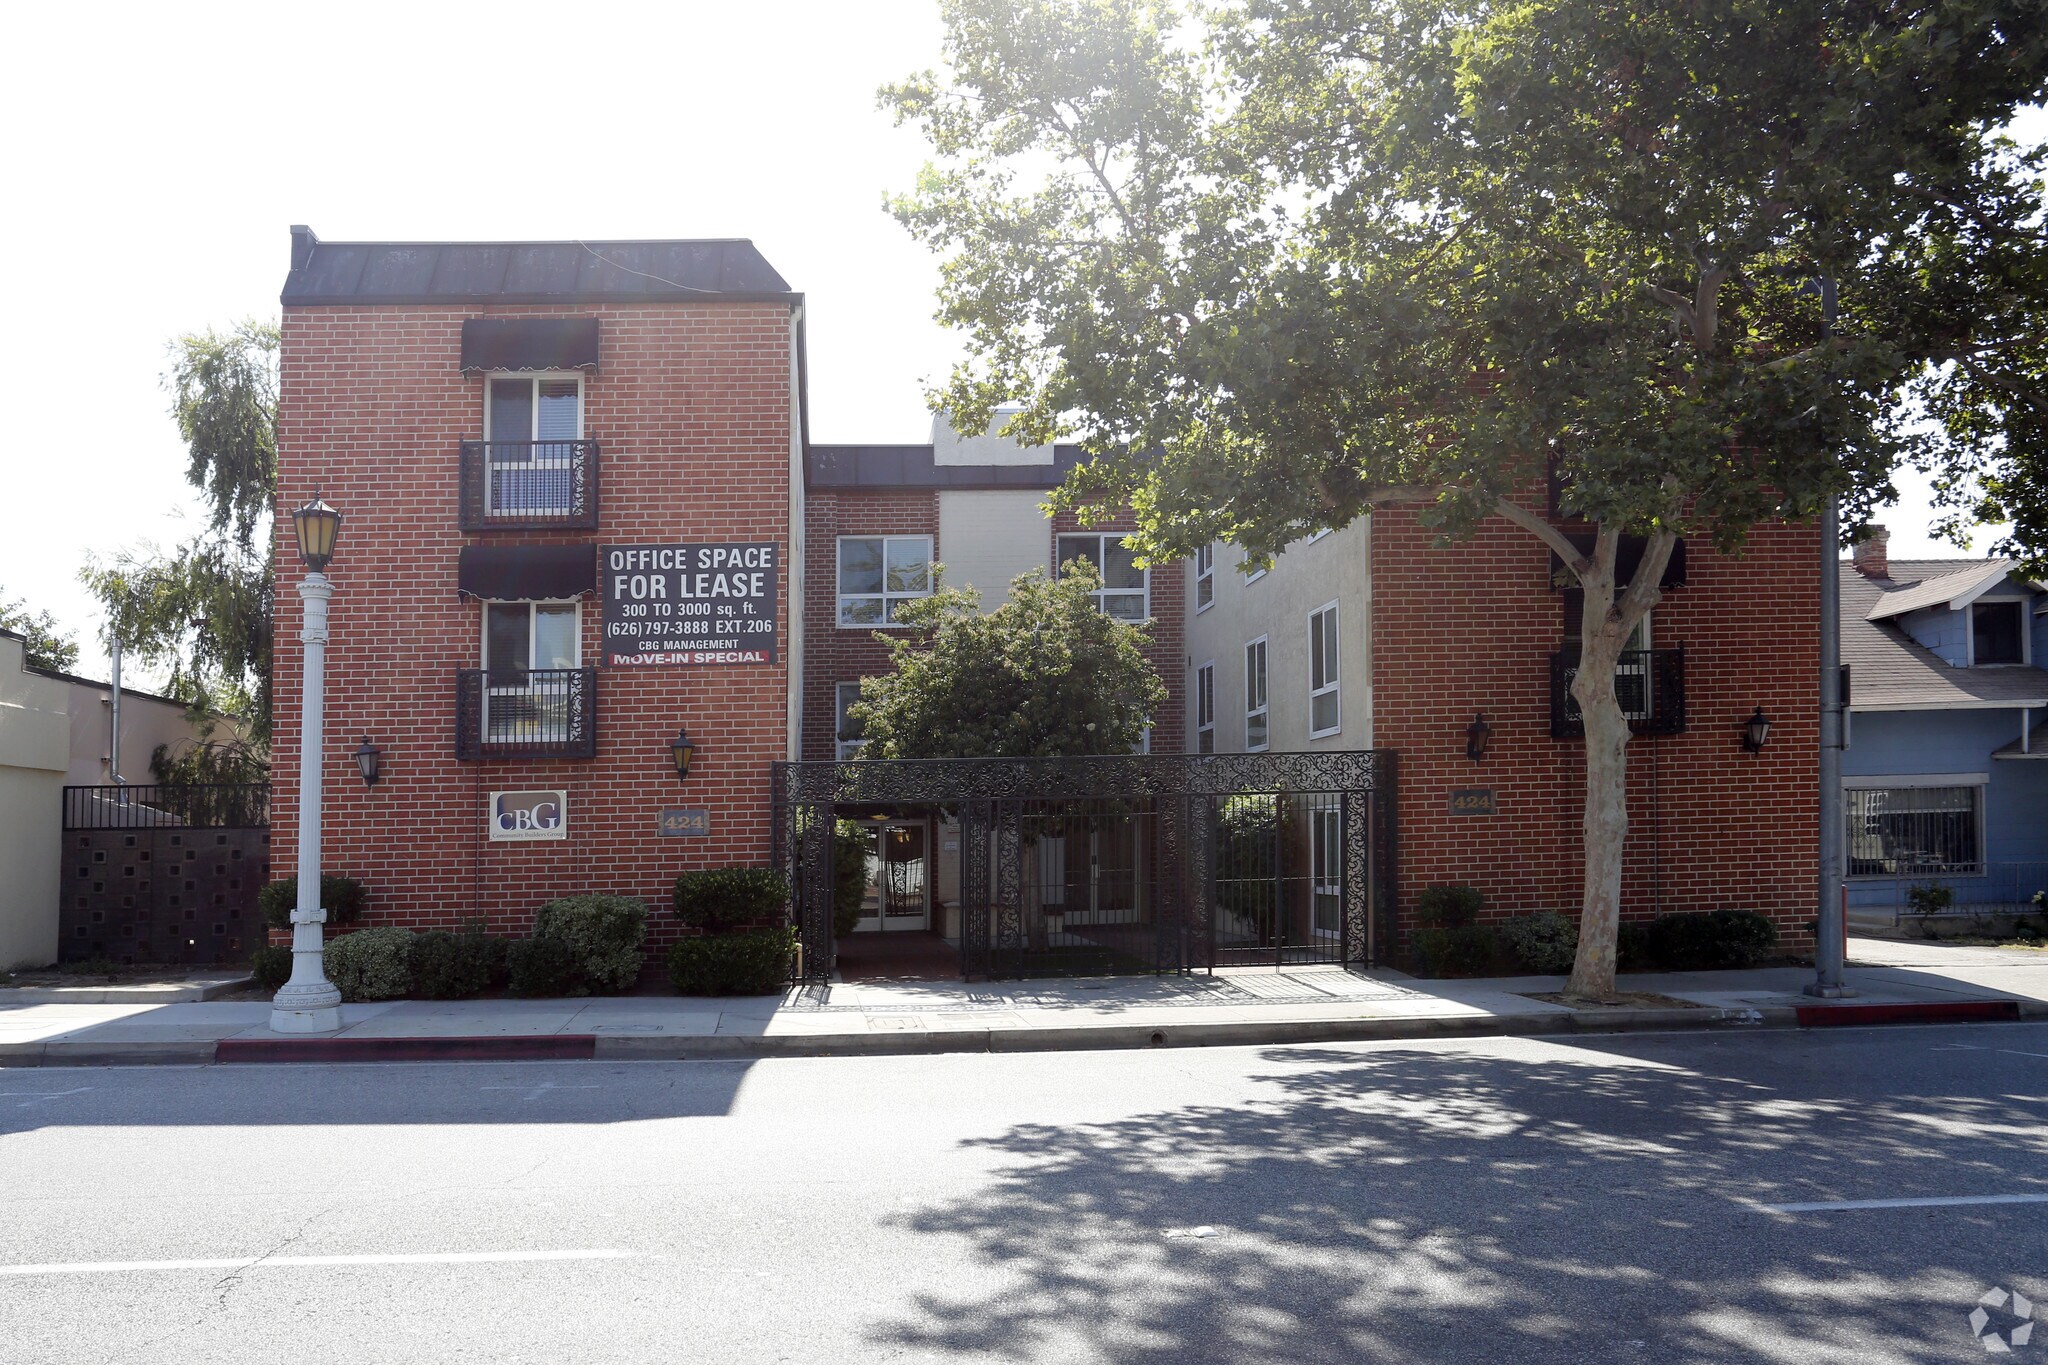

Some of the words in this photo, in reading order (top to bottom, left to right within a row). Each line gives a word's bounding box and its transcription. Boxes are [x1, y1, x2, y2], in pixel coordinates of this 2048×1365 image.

[610, 549, 687, 570] OFFICE
[697, 547, 772, 569] SPACE
[614, 574, 667, 599] FOR
[680, 572, 765, 598] LEASE
[622, 604, 647, 617] 300
[653, 603, 671, 616] TO
[677, 602, 711, 615] 3000
[717, 604, 736, 617] sq.
[742, 601, 757, 614] ft.
[715, 619, 772, 634] EXT.206
[638, 640, 659, 650] CBG
[663, 639, 739, 650] MANAGEMENT
[613, 653, 689, 664] MOVE-IN
[694, 651, 764, 663] SPECIAL
[1455, 795, 1491, 808] 424
[497, 802, 557, 831] CBG
[664, 816, 704, 829] 424
